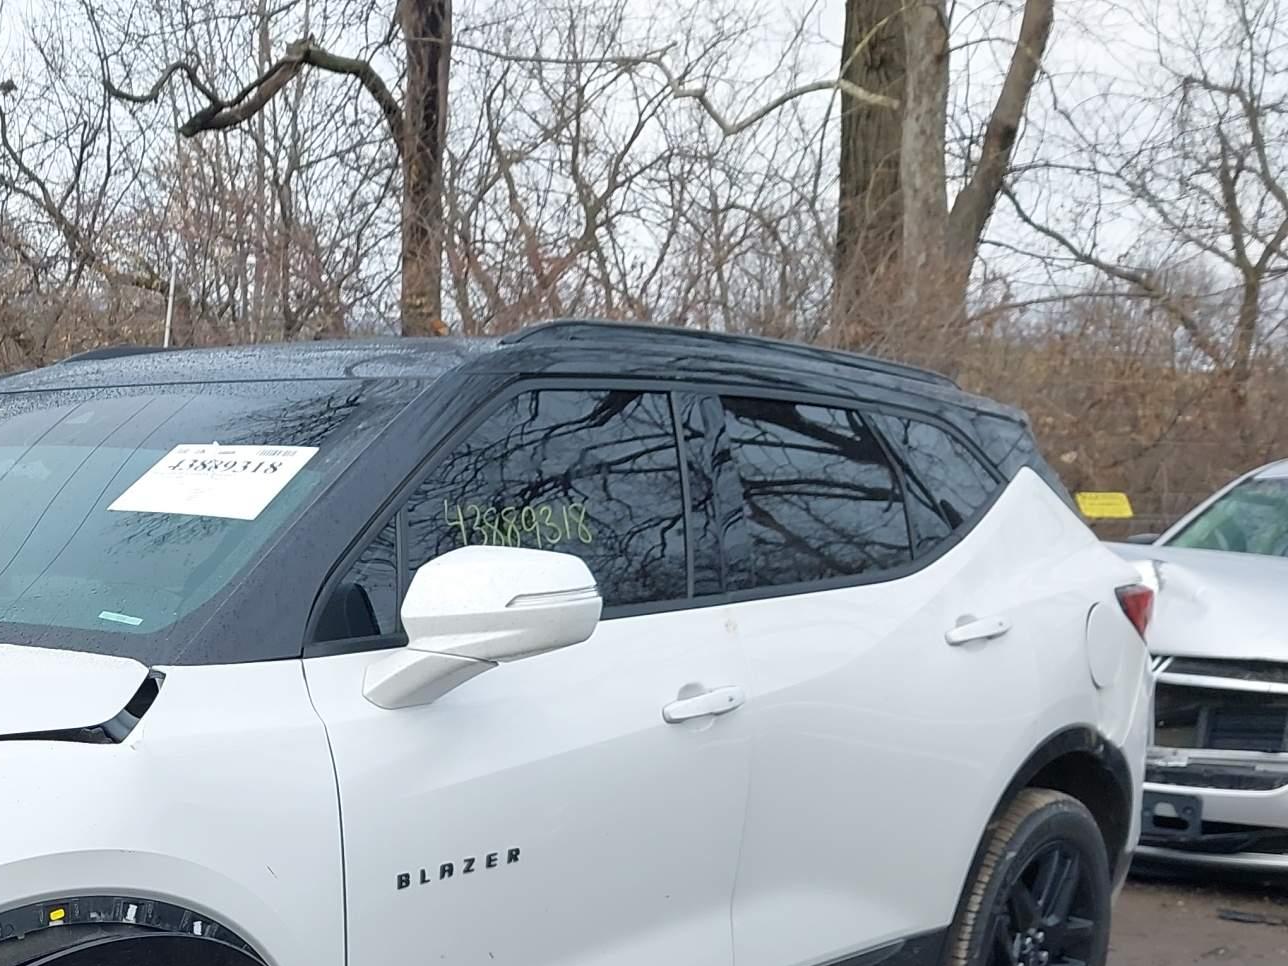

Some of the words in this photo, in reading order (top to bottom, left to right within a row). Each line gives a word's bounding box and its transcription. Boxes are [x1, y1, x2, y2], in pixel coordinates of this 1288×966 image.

[168, 458, 283, 474] 43889318
[444, 499, 592, 548] 43889318
[396, 847, 521, 890] BLAZER
